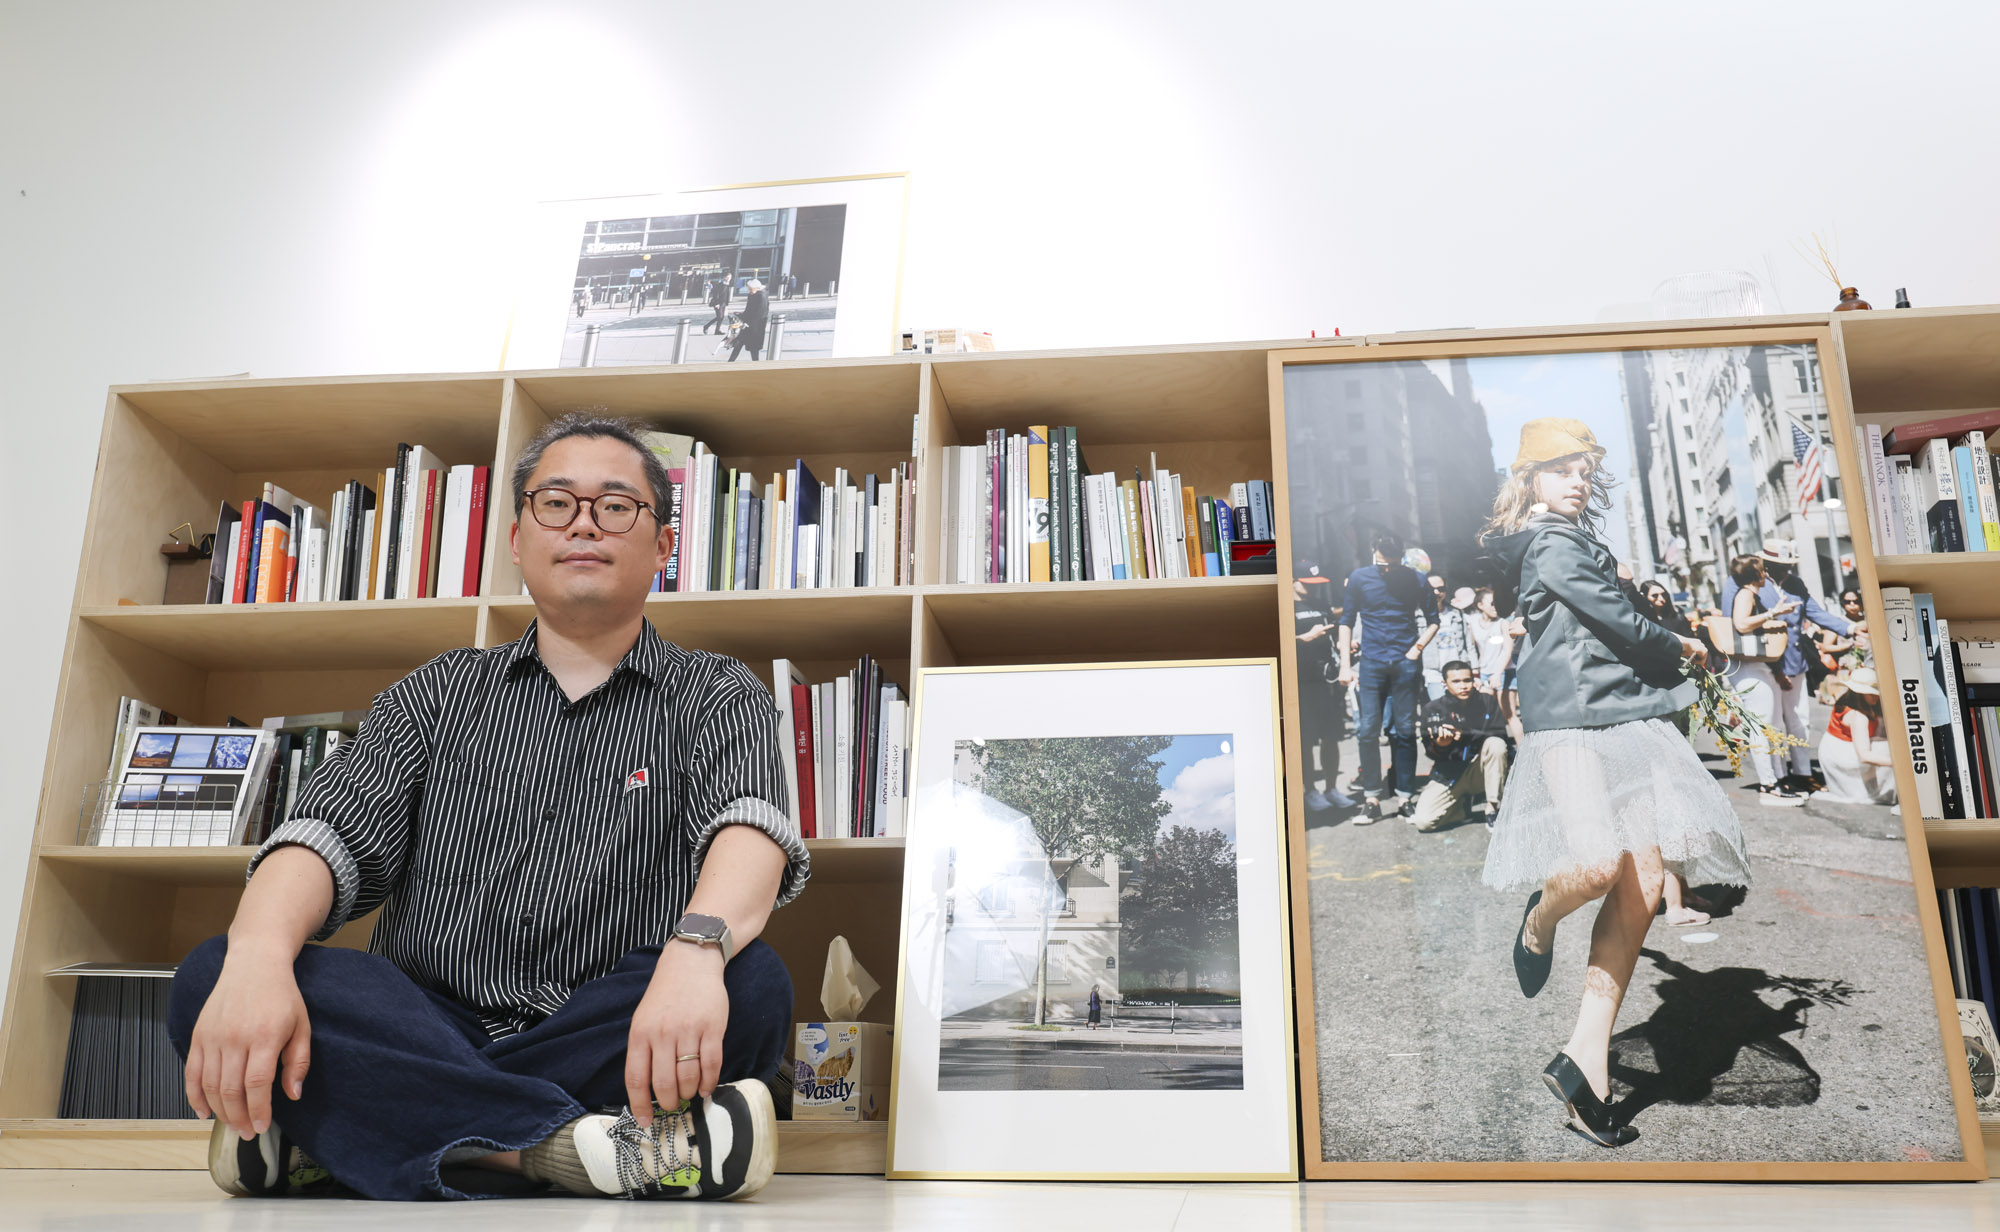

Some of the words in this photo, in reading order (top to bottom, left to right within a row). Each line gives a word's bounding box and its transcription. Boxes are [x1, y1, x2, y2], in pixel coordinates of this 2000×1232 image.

[1871, 433, 1880, 450] THE
[1873, 452, 1886, 487] HANOK
[1974, 446, 1986, 485] 地方設計
[671, 484, 682, 514] PUBLIC
[670, 517, 680, 534] ART
[666, 557, 677, 579] HERO
[1940, 626, 1949, 639] SOU
[1942, 641, 1953, 670] FUJIMOTO
[1947, 672, 1957, 696] RECENT
[1952, 698, 1961, 725] PROJECT
[1902, 679, 1928, 774] bauhaus
[803, 1077, 856, 1102] Vastly
